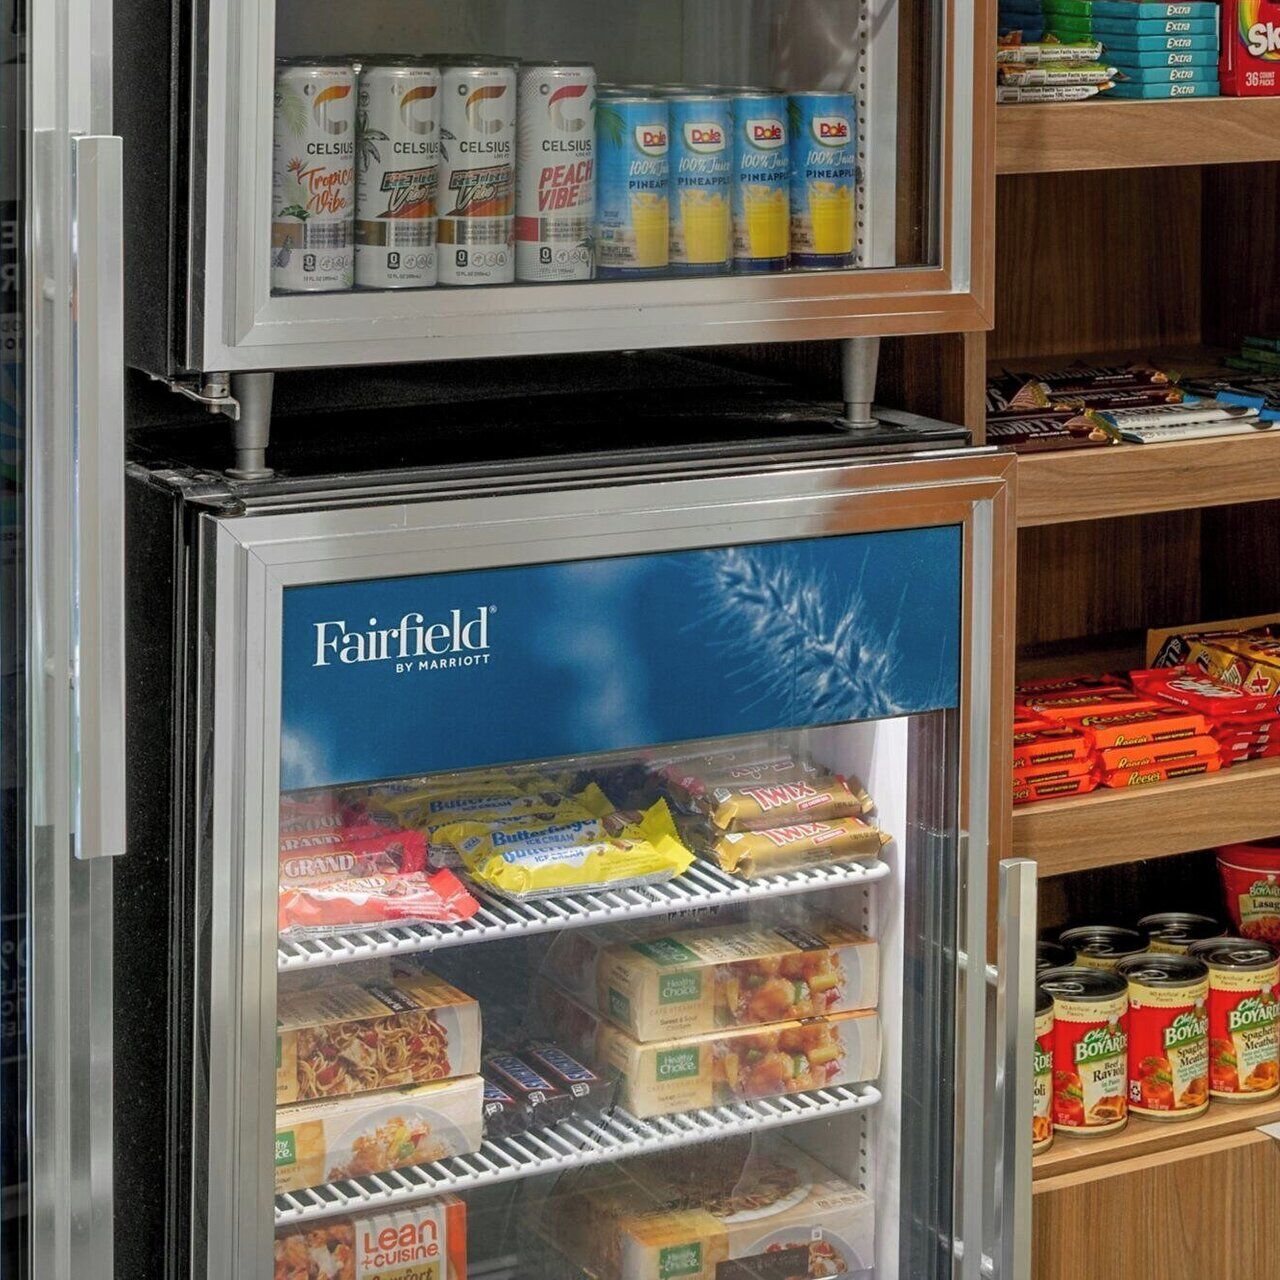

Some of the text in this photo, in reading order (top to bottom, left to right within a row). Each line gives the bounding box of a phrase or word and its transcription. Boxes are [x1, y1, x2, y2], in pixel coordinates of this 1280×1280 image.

[1167, 5, 1190, 16] Extra
[1165, 21, 1189, 32] Extra
[1167, 37, 1190, 48] Extra
[1168, 53, 1192, 64] Extra
[1170, 69, 1192, 80] Extra
[1245, 72, 1258, 85] 36
[1171, 85, 1194, 95] Extra
[754, 125, 781, 139] Dole
[821, 123, 847, 136] Dole
[644, 132, 666, 146] Dole
[692, 129, 720, 144] Dole
[307, 143, 353, 155] CELSIUS
[394, 142, 439, 154] CELSIUS
[460, 141, 510, 153] CELSIUS
[543, 140, 592, 152] CELSIUS
[679, 158, 706, 172] 100%
[741, 154, 768, 169] 100%
[806, 151, 833, 166] 100%
[539, 160, 593, 188] PEACH
[306, 189, 346, 214] Vibe
[538, 186, 579, 211] VIBE
[312, 606, 491, 667] Fairfield
[396, 653, 491, 674] BY MARRIOTT
[1128, 772, 1160, 785] Reese's
[742, 781, 816, 810] TWIX
[753, 822, 830, 846] TWIX
[285, 853, 354, 878] GRAND
[1238, 999, 1260, 1010] Chef
[1174, 1014, 1193, 1027] Chef
[1084, 1030, 1105, 1042] Chef
[364, 1220, 437, 1254] Lean
